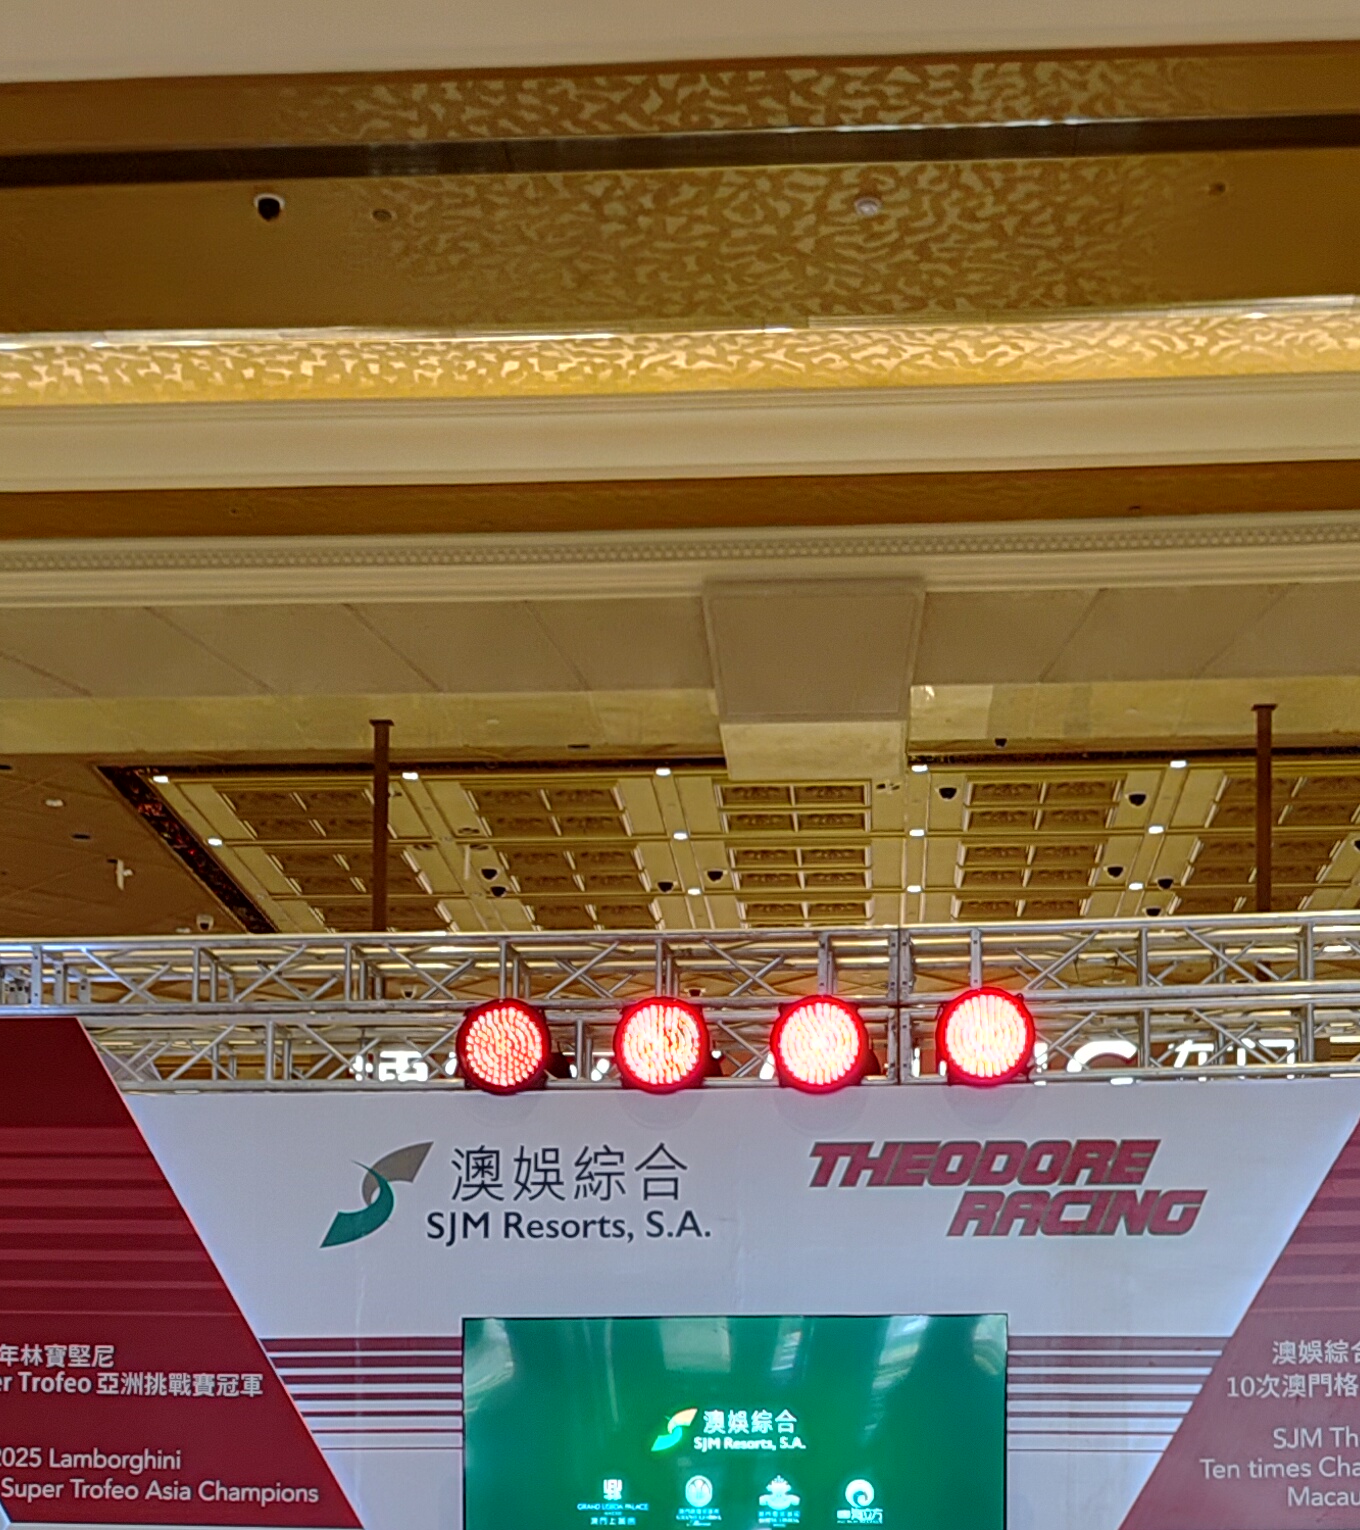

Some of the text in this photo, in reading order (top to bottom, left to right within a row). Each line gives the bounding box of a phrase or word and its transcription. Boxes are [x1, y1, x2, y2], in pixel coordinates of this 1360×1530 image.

[450, 1143, 689, 1201] 澳娛綜合
[809, 1139, 1161, 1188] THEODORE
[946, 1188, 1207, 1237] RACING
[426, 1208, 712, 1248] SJM Resorts, S.A.
[18, 1371, 92, 1394] Trofeo
[703, 1409, 797, 1435] 澳娛綜合
[694, 1436, 721, 1452] SJM
[780, 1436, 807, 1450] S.A.
[1273, 1428, 1322, 1450] SJM
[49, 1447, 182, 1474] Lamborghini
[1200, 1458, 1239, 1480] Ten
[1247, 1457, 1311, 1478] times
[1, 1478, 319, 1507] Super Trofeo Asia Champions
